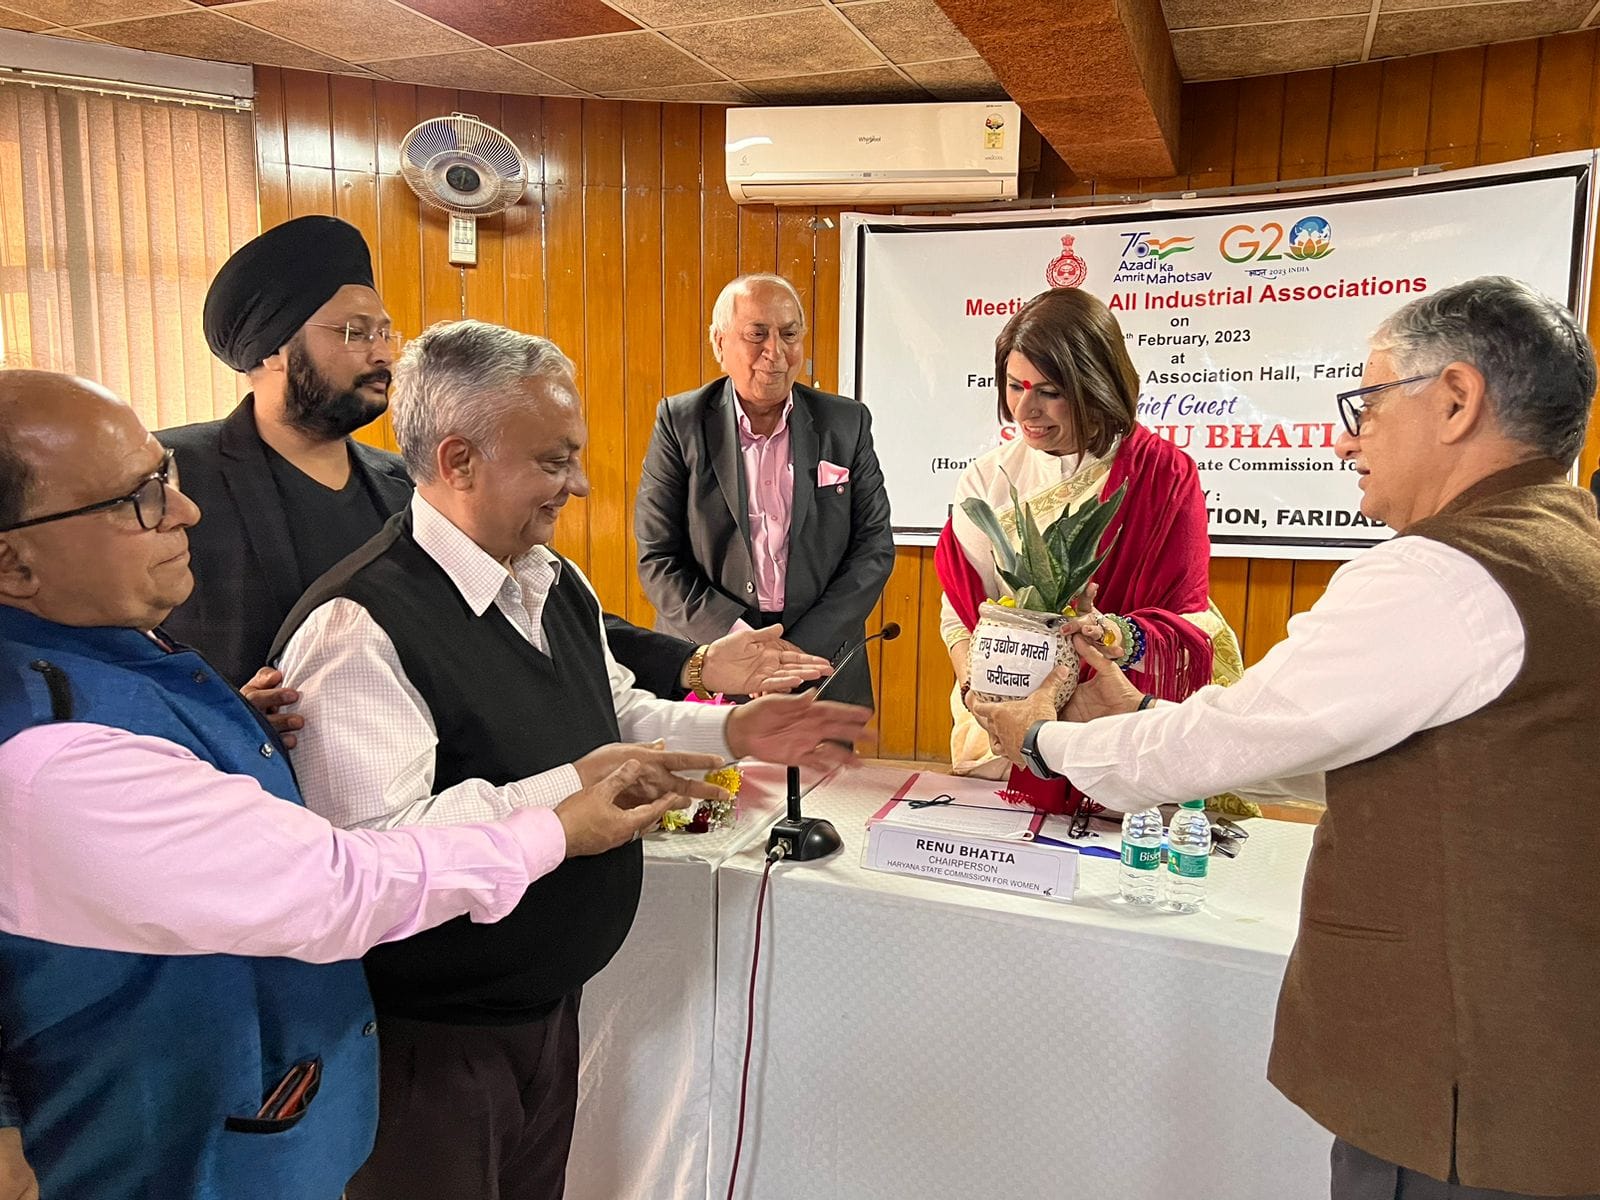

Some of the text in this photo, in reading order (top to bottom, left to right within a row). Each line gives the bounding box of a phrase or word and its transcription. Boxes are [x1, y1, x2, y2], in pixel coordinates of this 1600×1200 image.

[1119, 258, 1173, 272] Azadi Ka
[1113, 272, 1212, 284] Amrit Mahotsav
[966, 276, 1427, 316] Meeti All Industrial Associations
[1170, 317, 1189, 328] on
[1138, 334, 1209, 348] February,
[1214, 330, 1251, 344] 2023
[1171, 353, 1185, 365] at
[1145, 367, 1253, 385] Association
[1260, 365, 1300, 383] Hall,
[1137, 393, 1238, 421] hief Guest
[1205, 423, 1337, 449] BHATI
[931, 457, 1358, 474] (Hon' ate Commission fo
[1206, 508, 1267, 529] TION,
[1020, 641, 1049, 661] भारती
[916, 838, 1015, 865] RENU BHATIA
[928, 855, 998, 874] CHAIRPERSON
[887, 859, 1040, 891] HARYANA STATE COMMISSION FOR WOMEN
